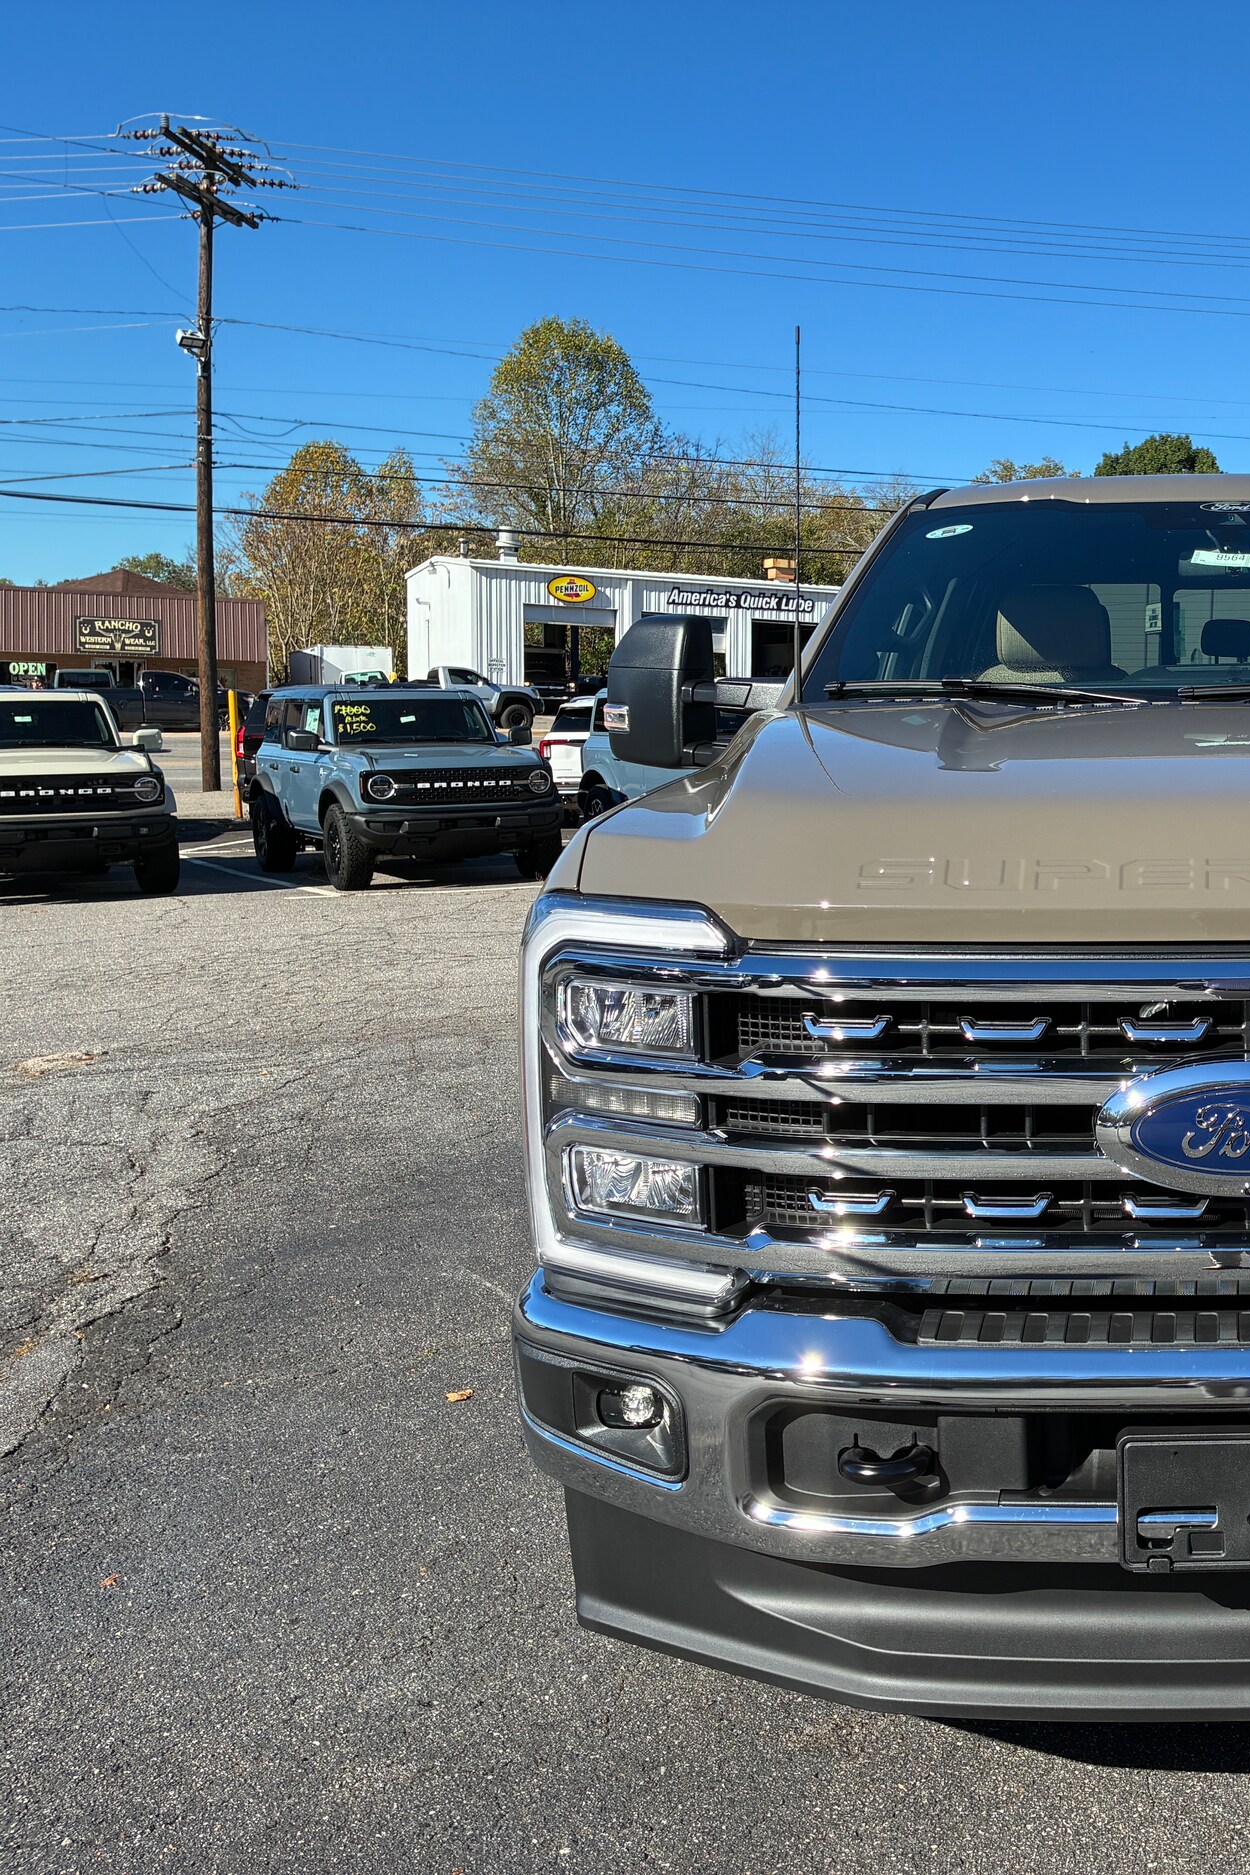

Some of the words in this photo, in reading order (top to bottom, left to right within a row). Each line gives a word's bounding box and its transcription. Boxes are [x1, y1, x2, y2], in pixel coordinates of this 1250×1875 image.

[1210, 502, 1250, 511] Ford
[555, 584, 590, 594] PENNZOIL
[669, 589, 737, 607] America's
[740, 593, 778, 610] Quick
[781, 595, 813, 611] Lube
[94, 620, 141, 632] RANCHO
[9, 662, 46, 675] OPEN
[417, 779, 512, 789] BRONCO
[0, 788, 112, 797] BRONCO
